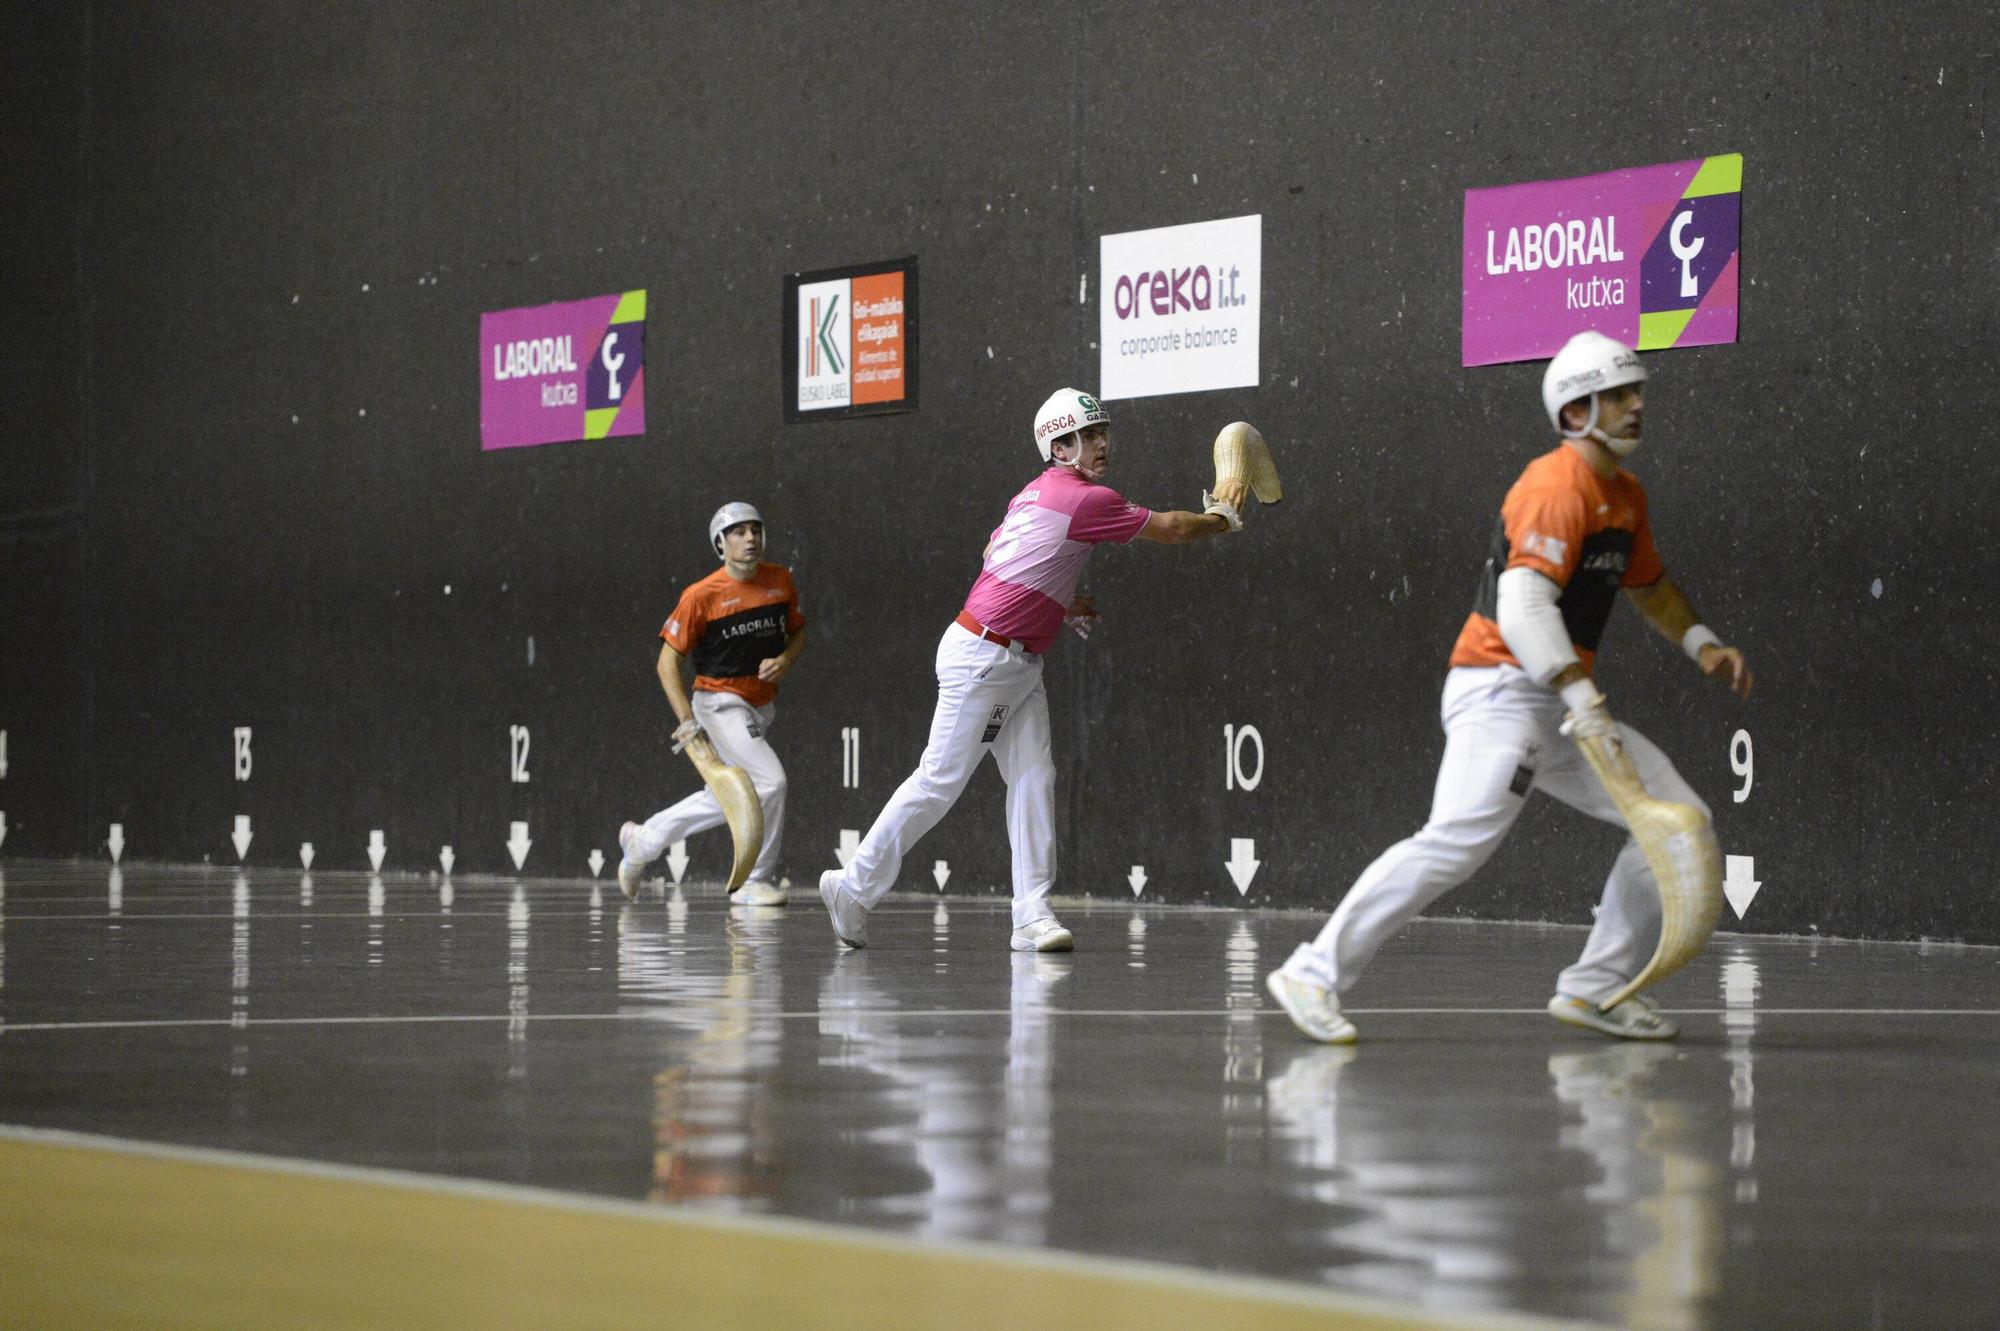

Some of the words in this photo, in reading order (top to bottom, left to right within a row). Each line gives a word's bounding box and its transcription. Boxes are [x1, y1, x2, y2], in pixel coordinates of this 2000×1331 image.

[1486, 215, 1624, 275] LABORAL
[1114, 264, 1212, 320] oreka
[1218, 262, 1247, 309] i.t.
[1566, 275, 1625, 310] kutxa
[494, 334, 578, 381] LABORAL
[1120, 329, 1182, 359] corporate
[1184, 325, 1238, 350] balance
[541, 381, 578, 408] kutxa
[825, 382, 849, 400] LABEL
[1035, 413, 1077, 441] INPESCA
[722, 615, 777, 640] LABORAL
[233, 726, 253, 782] 13
[510, 724, 531, 783] 12
[841, 726, 860, 789] 11
[1223, 723, 1265, 792] 10
[1729, 728, 1754, 803] 9
